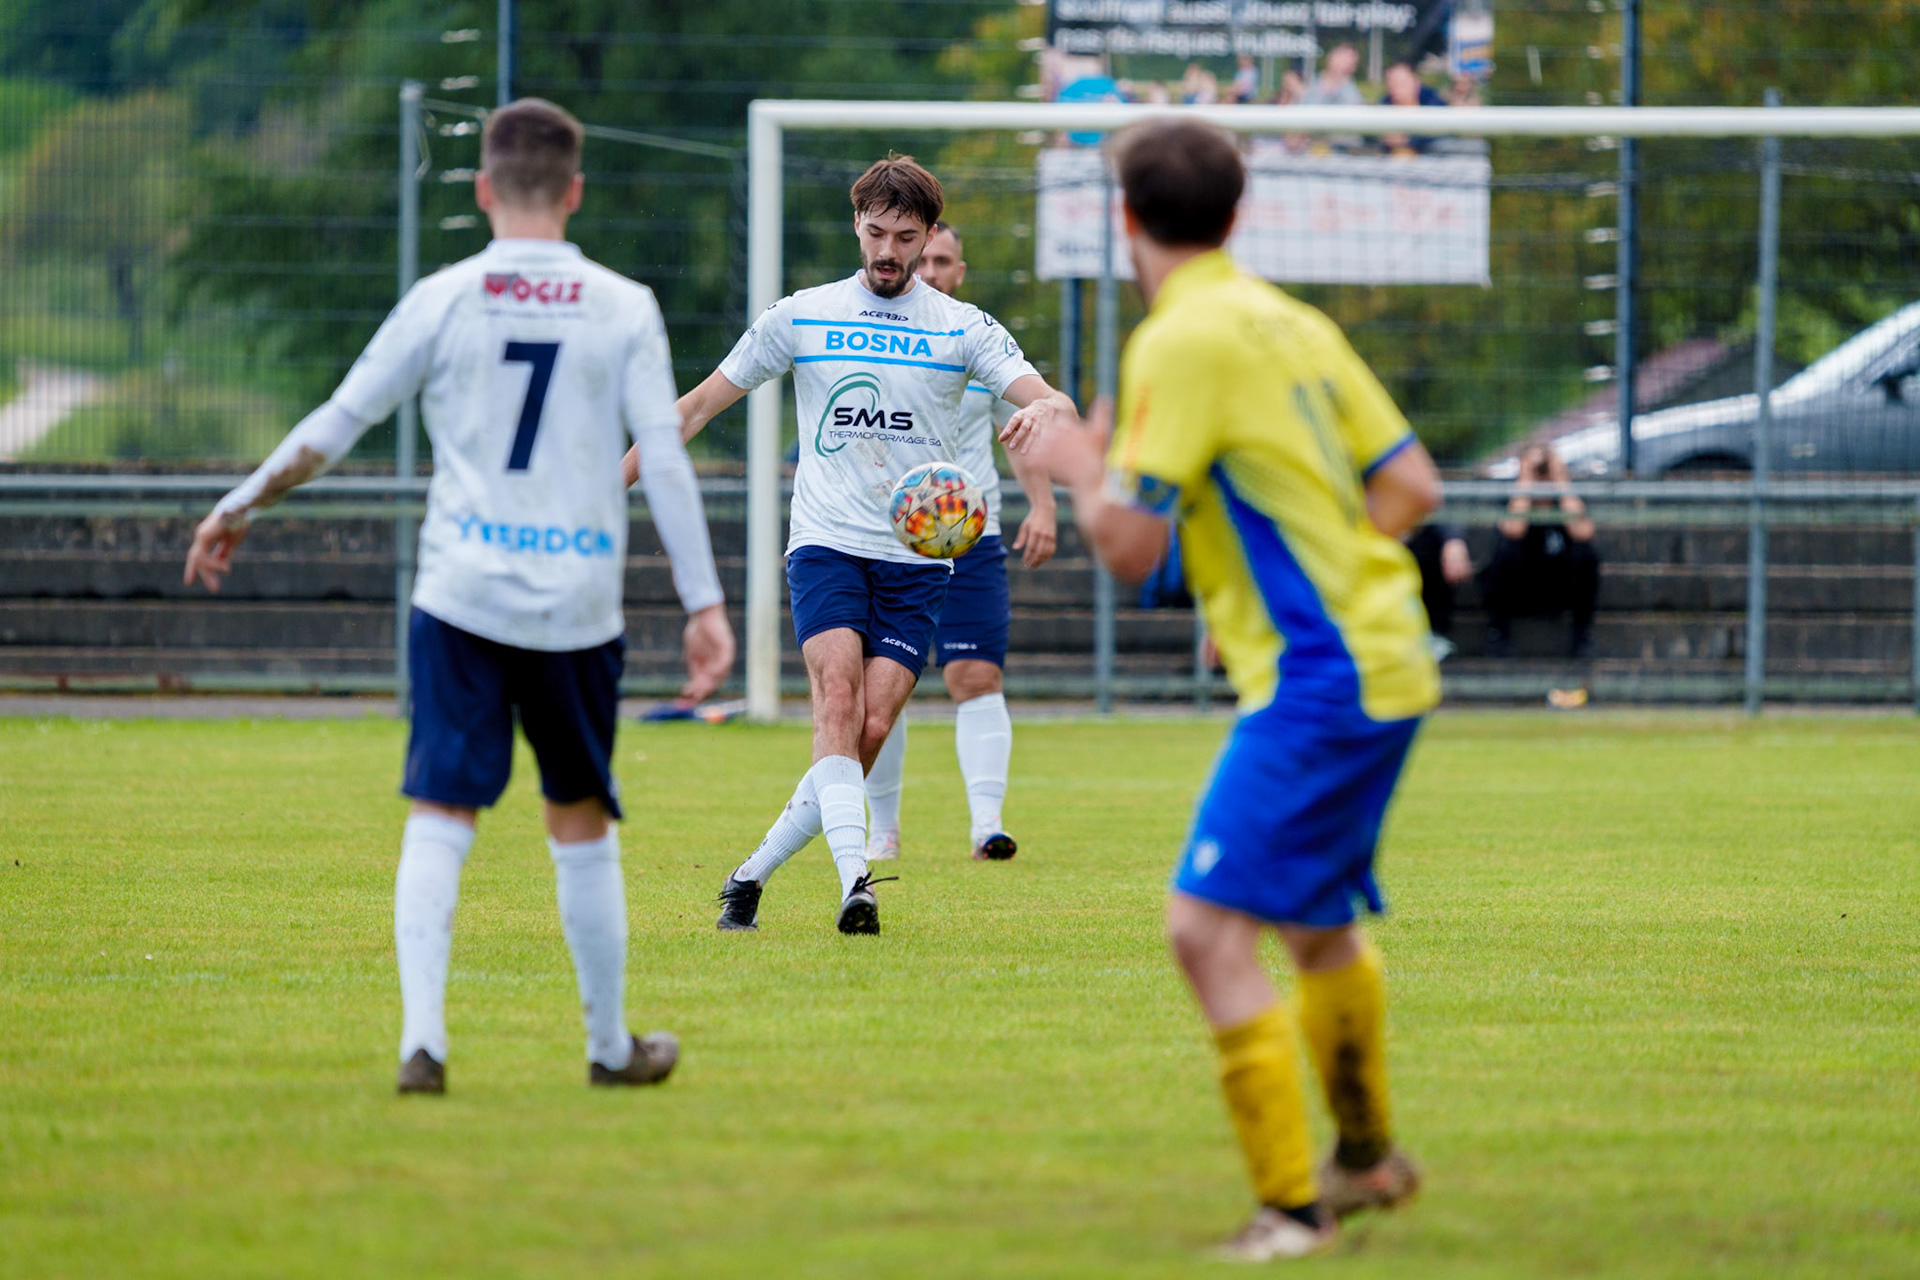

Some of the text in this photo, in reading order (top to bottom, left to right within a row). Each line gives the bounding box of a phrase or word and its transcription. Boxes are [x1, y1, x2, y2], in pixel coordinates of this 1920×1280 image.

[825, 330, 933, 357] BOSNA
[503, 341, 561, 471] 7
[833, 407, 913, 431] SMS
[828, 430, 942, 446] THERMOFORMAGE SA
